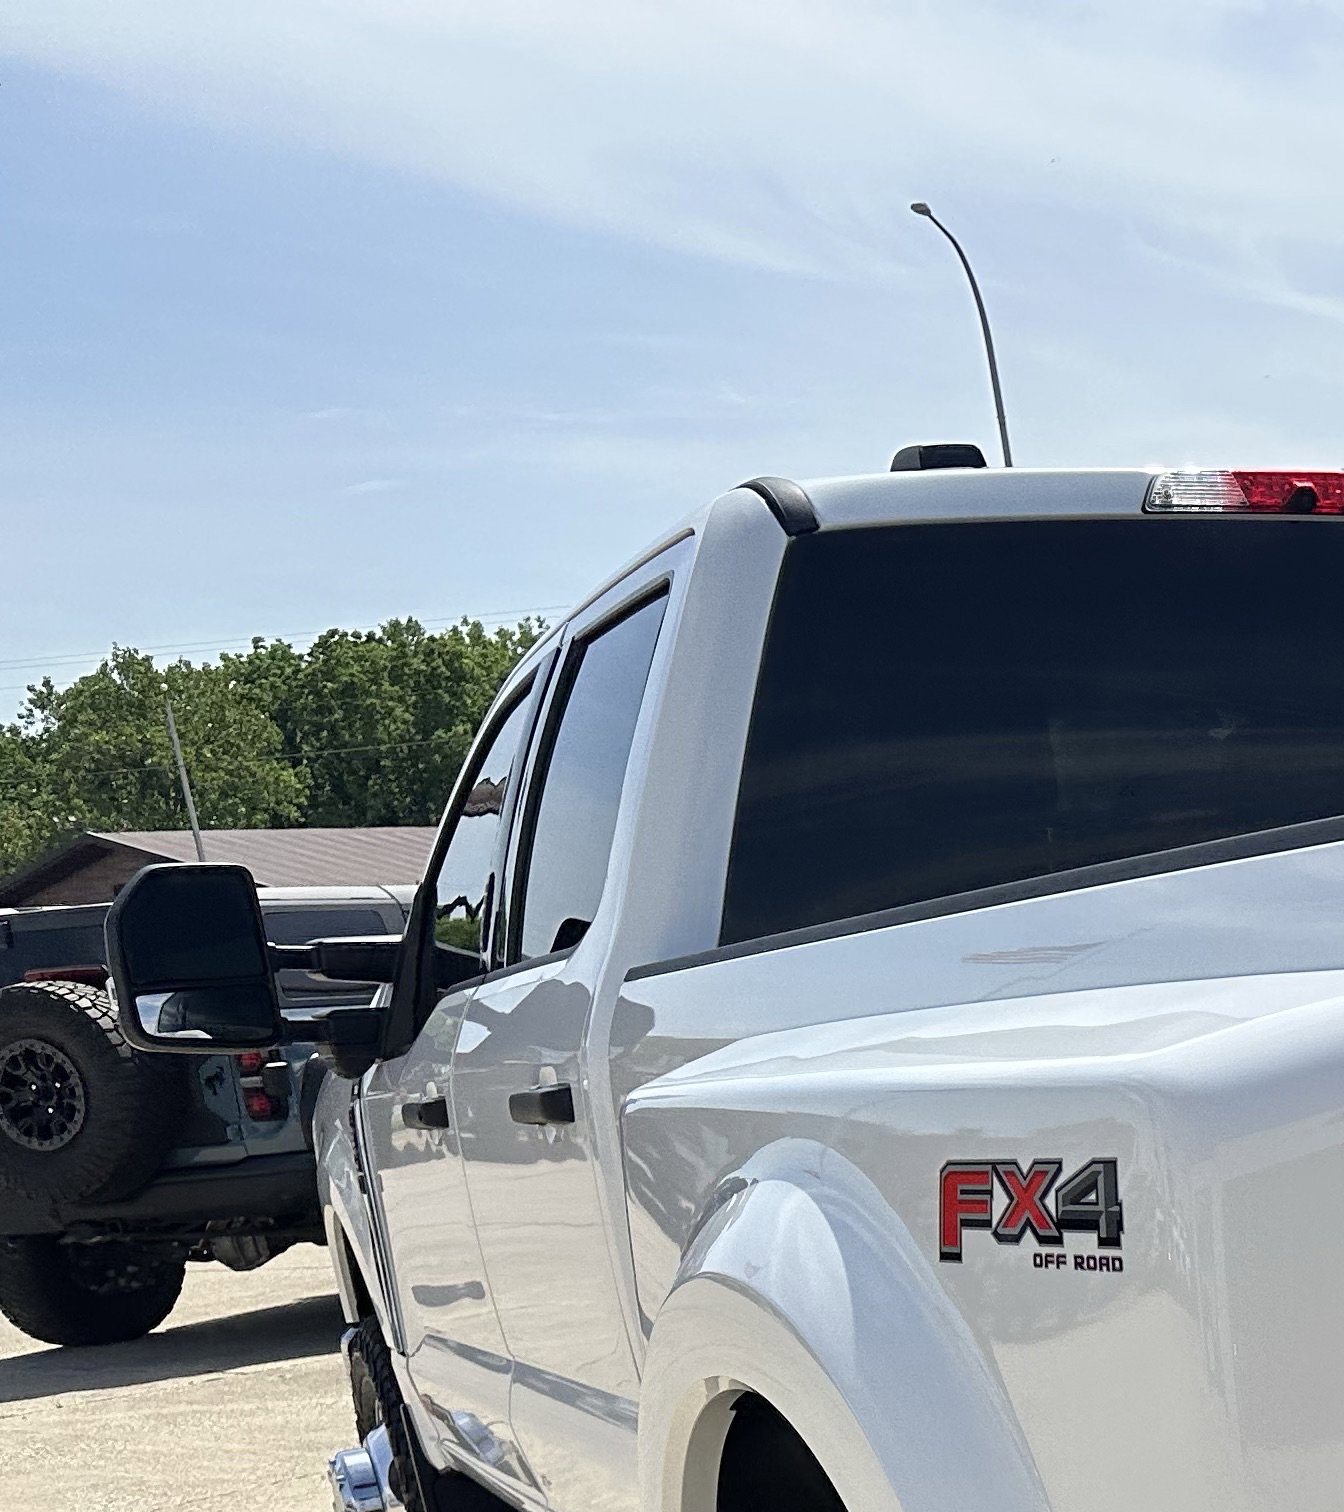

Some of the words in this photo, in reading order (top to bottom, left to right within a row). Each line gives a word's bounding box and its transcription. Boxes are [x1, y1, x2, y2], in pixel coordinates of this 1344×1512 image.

[939, 1157, 1124, 1264] FX4
[1032, 1252, 1067, 1270] OFF
[1073, 1253, 1124, 1273] ROAD
